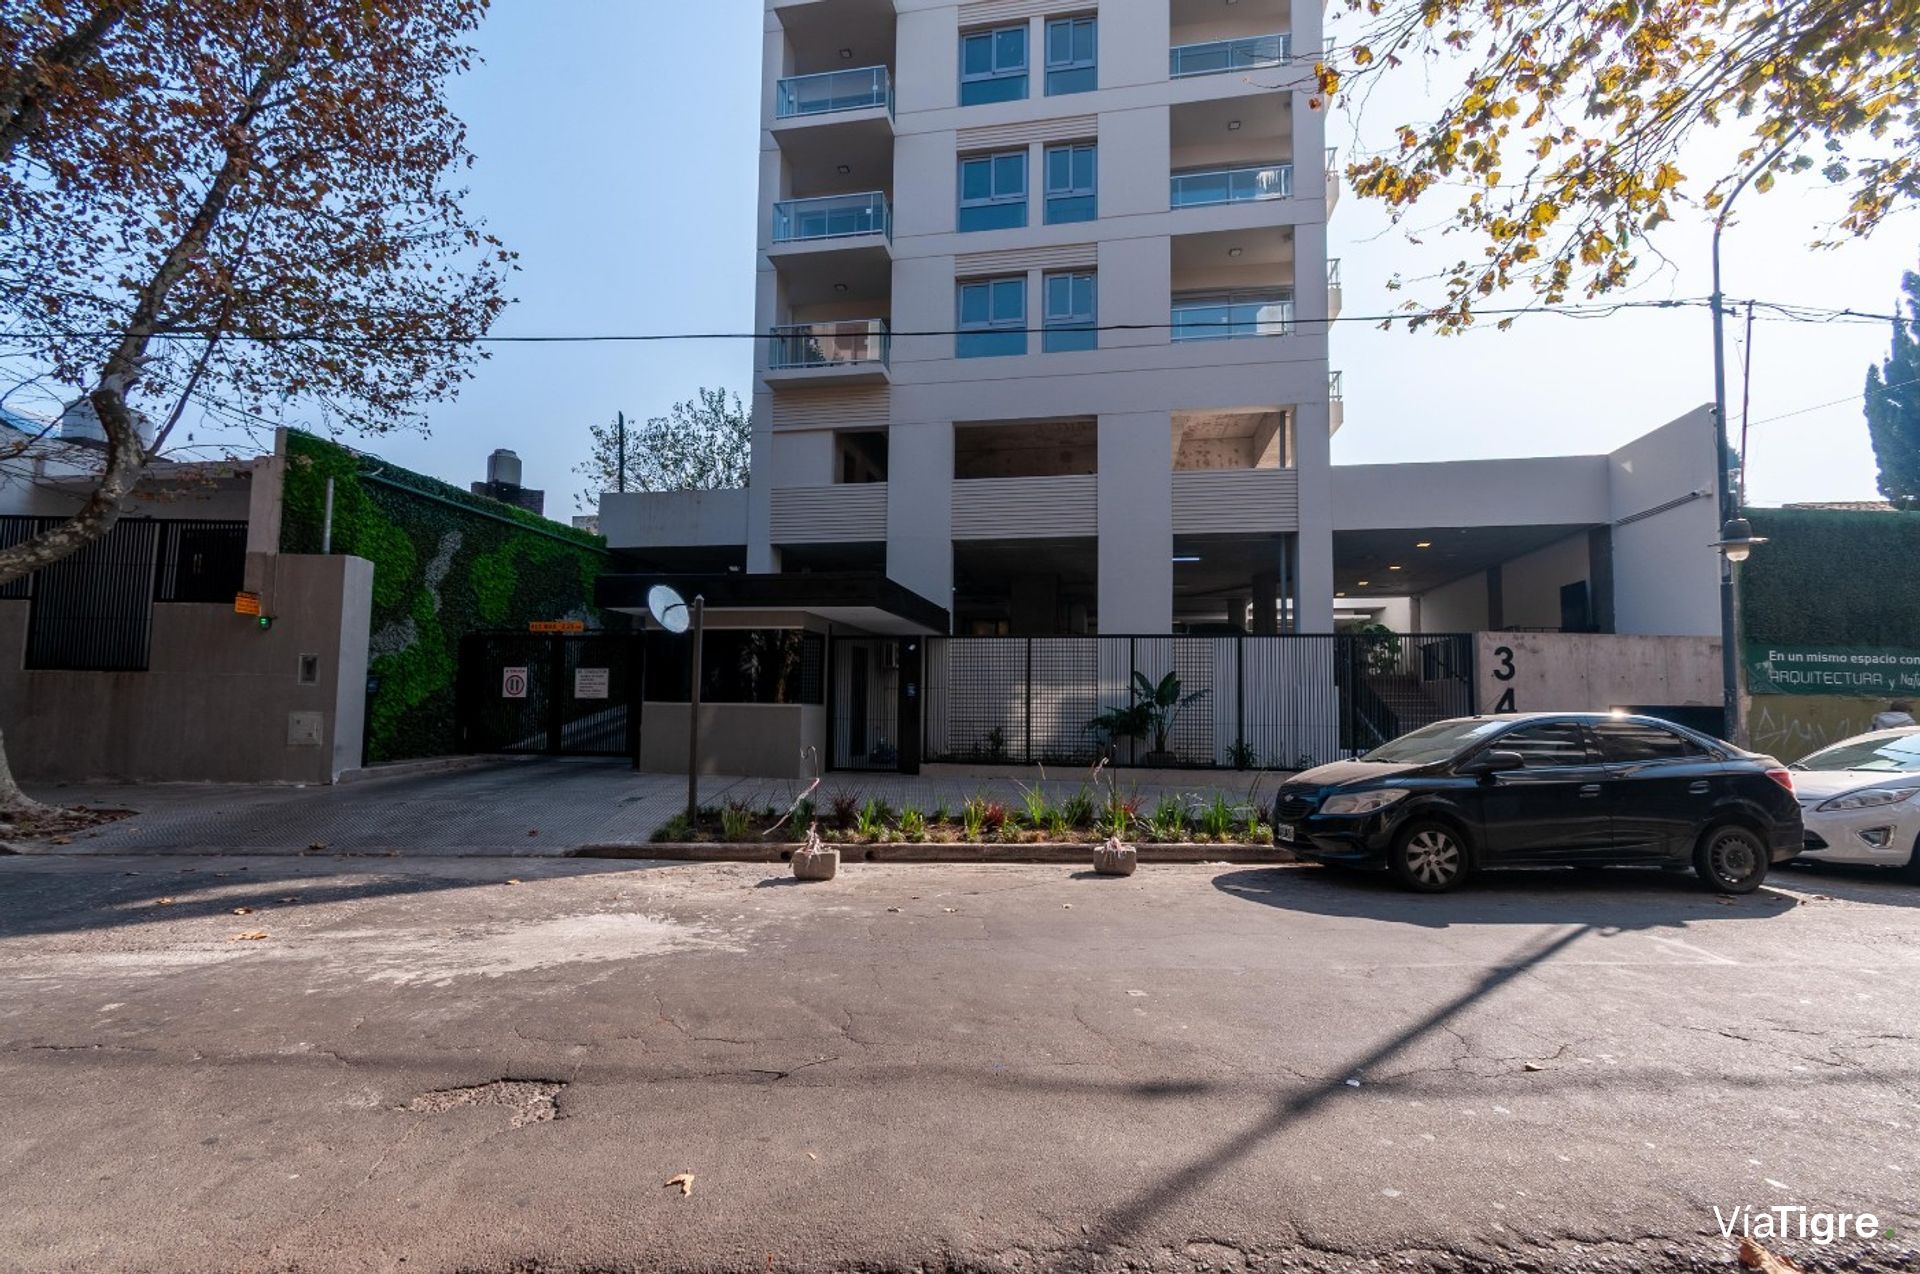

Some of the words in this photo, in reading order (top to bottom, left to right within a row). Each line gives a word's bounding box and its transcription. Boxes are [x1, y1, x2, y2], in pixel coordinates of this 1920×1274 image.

[1769, 650, 1784, 661] En
[1788, 652, 1803, 662] un
[1806, 651, 1848, 663] mismo
[1850, 653, 1897, 666] espacio
[1769, 670, 1882, 685] ARQUITECTURA
[1888, 679, 1895, 691] y
